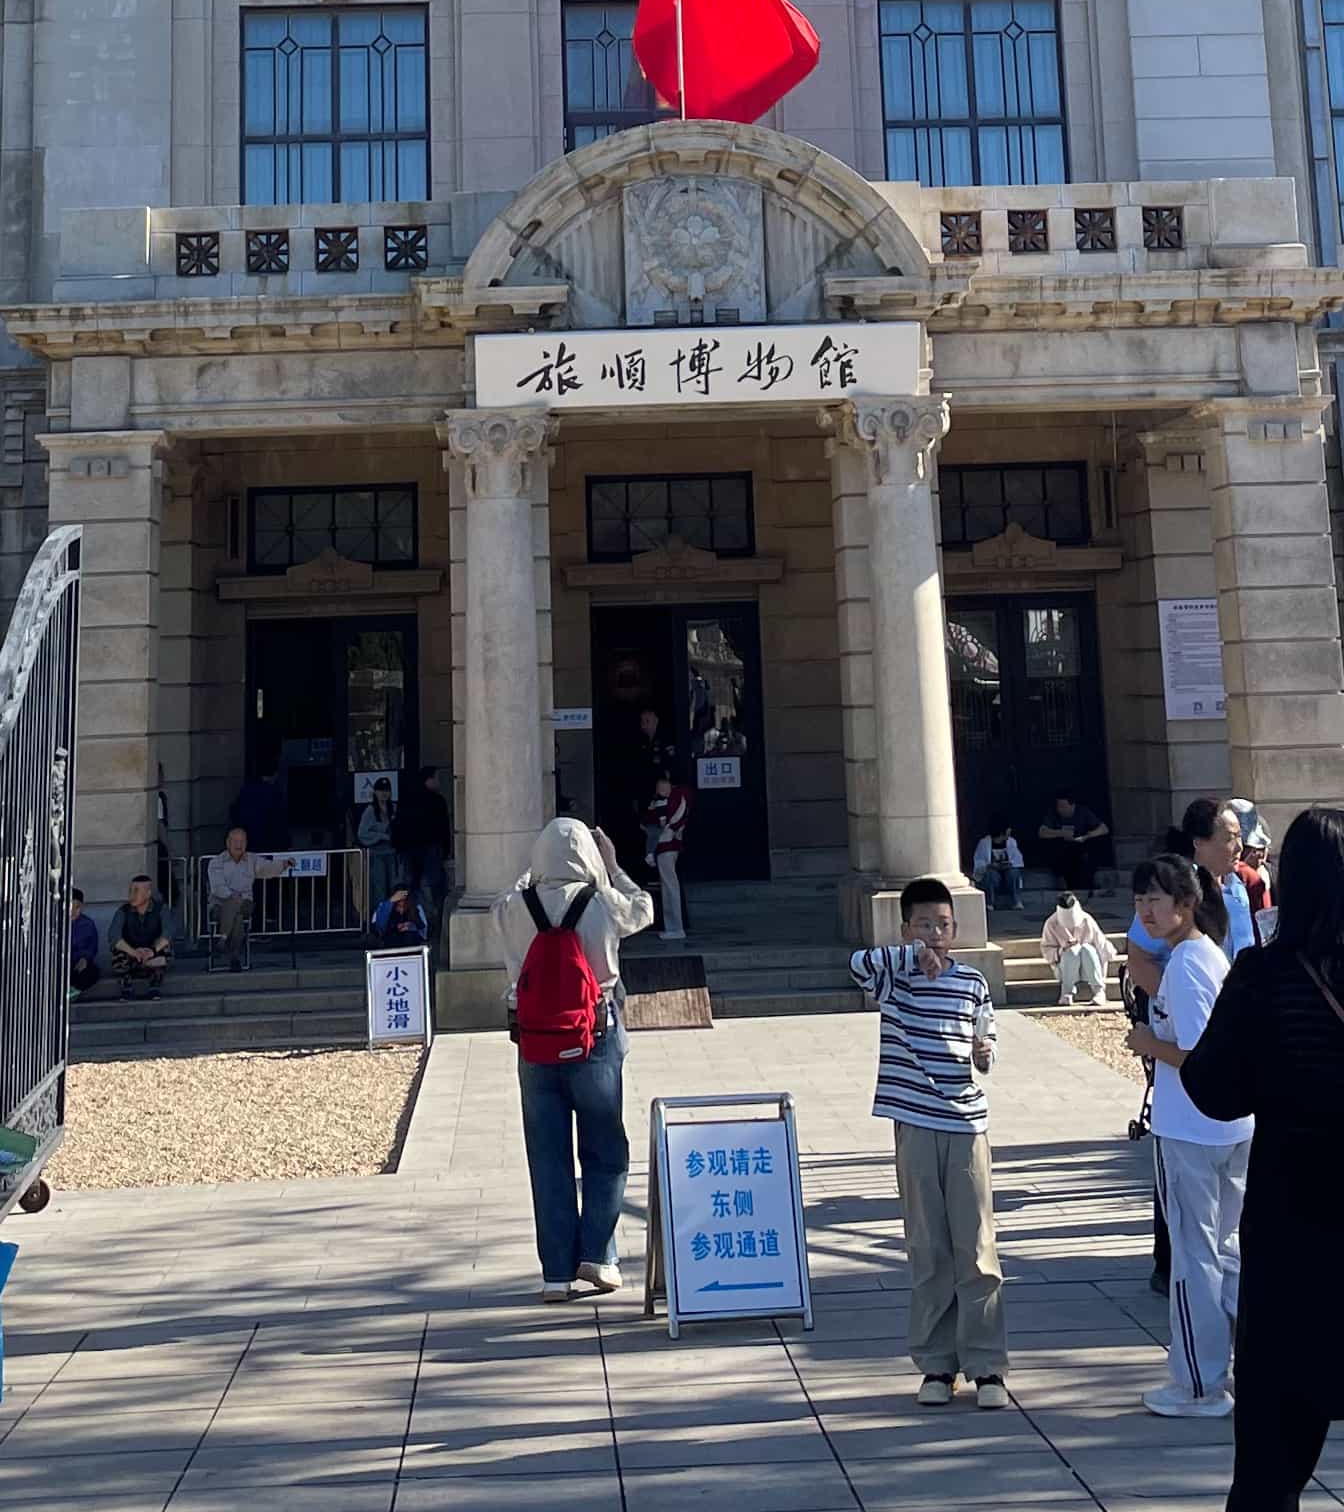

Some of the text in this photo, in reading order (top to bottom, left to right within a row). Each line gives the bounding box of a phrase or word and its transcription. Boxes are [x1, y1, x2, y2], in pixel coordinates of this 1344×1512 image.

[704, 761, 733, 775] 出口
[385, 966, 410, 1029] 小心地滑
[685, 1146, 774, 1178] 参观请走
[710, 1189, 753, 1218] 东侧
[690, 1228, 782, 1261] 参观通道
